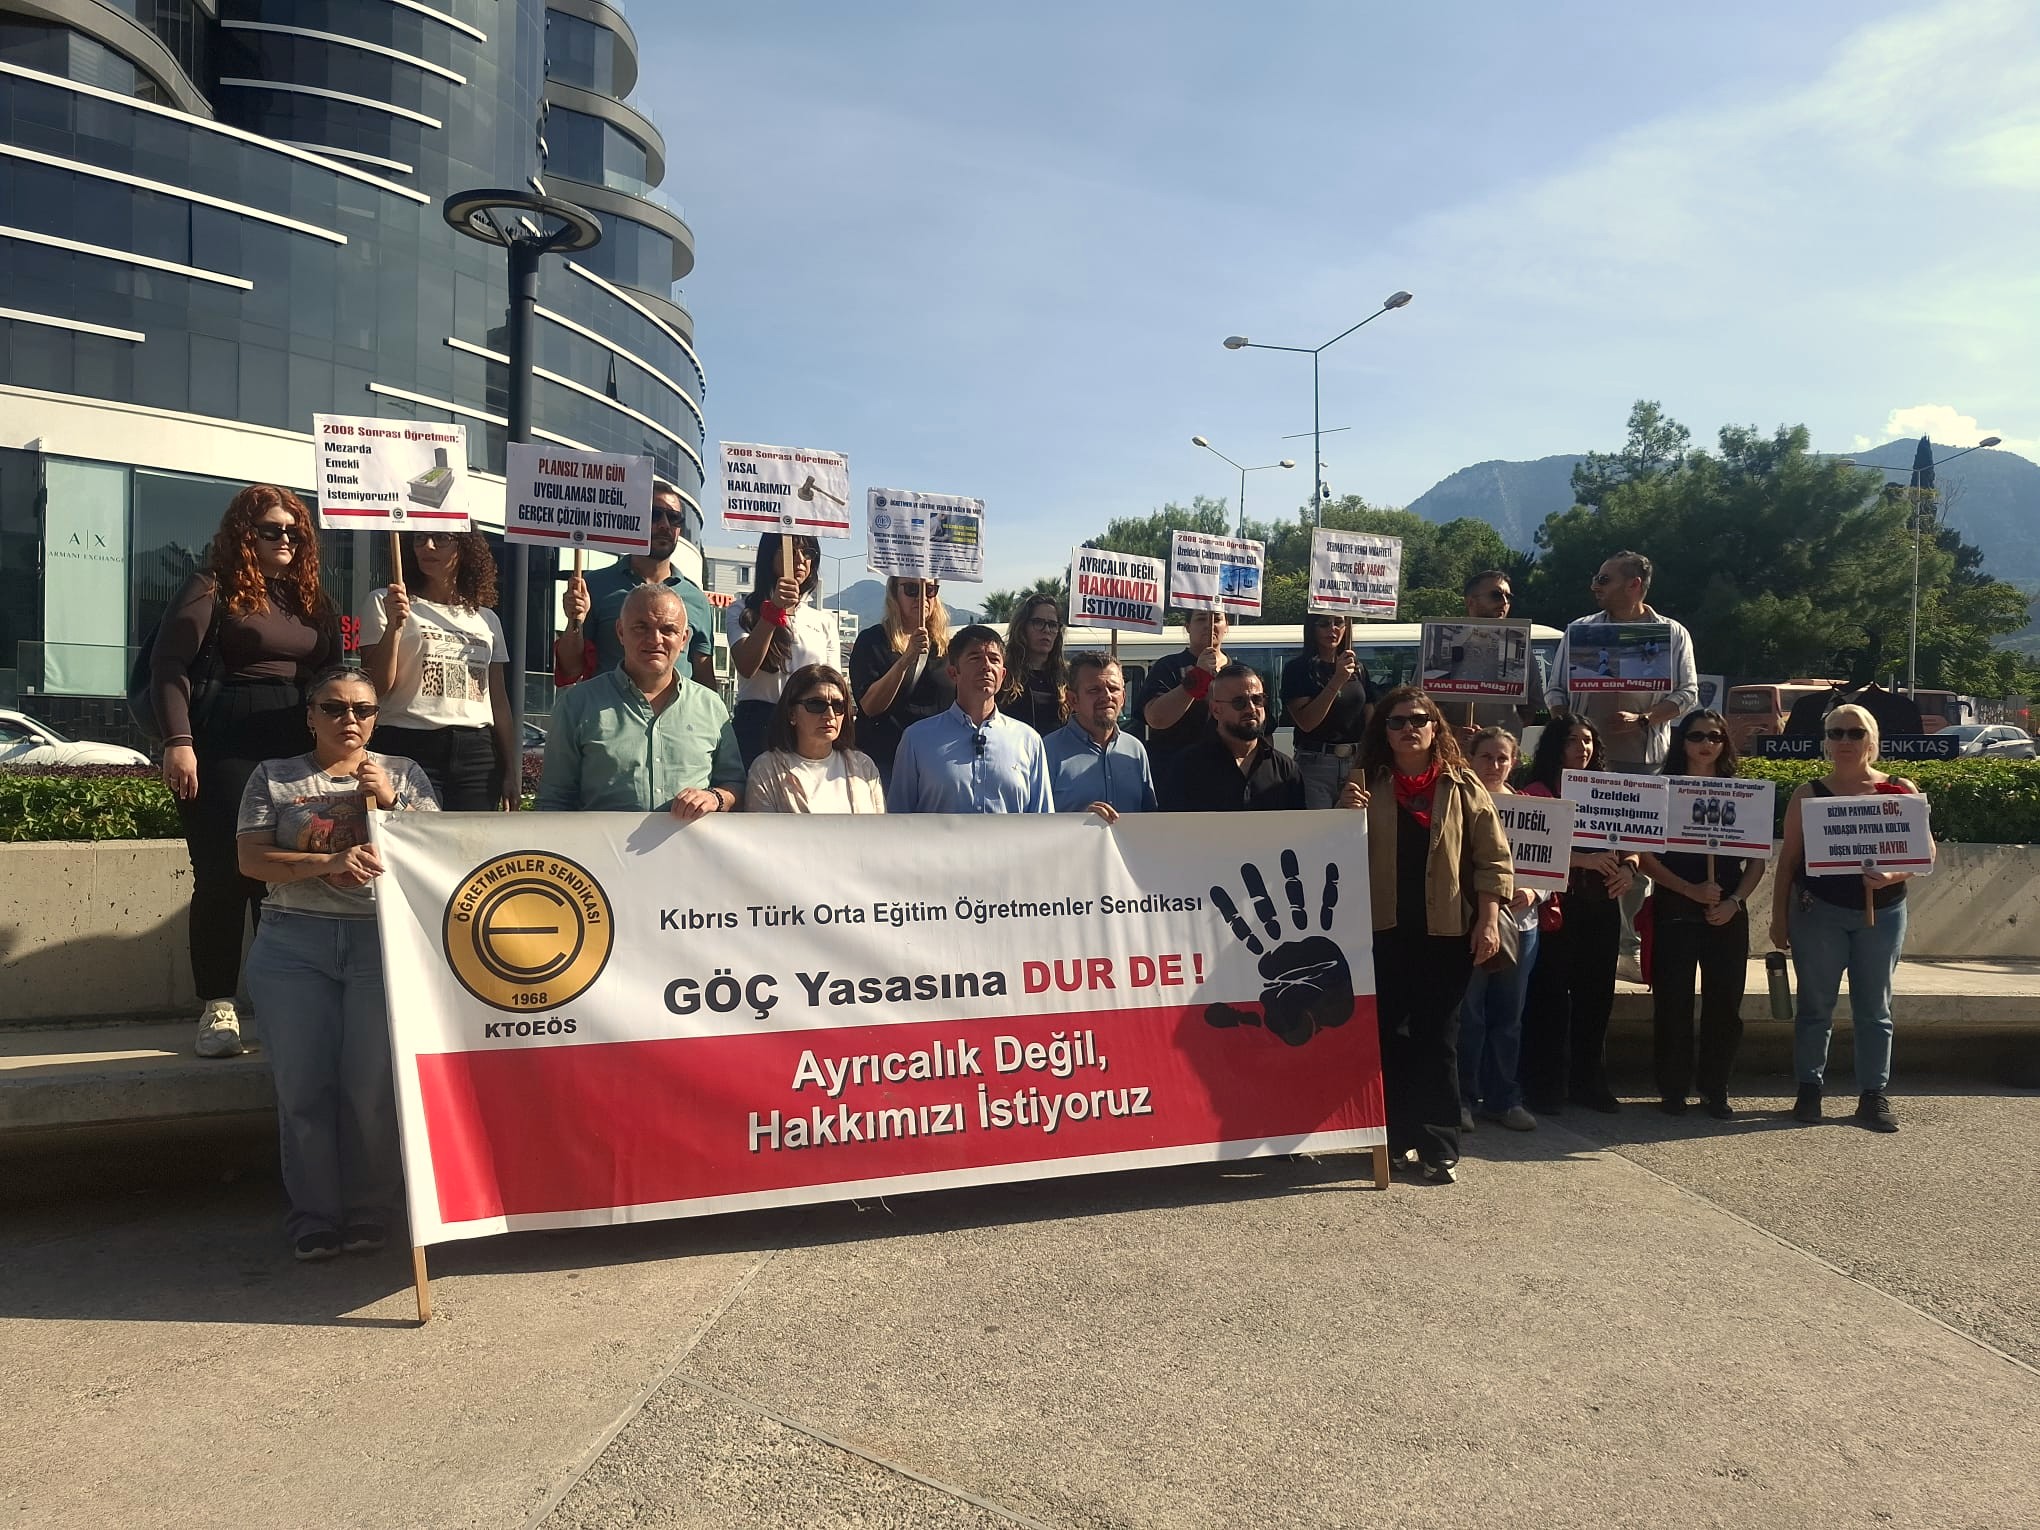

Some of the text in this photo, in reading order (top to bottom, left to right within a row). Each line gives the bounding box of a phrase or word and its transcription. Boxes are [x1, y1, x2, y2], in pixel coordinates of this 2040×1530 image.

[323, 424, 459, 443] 2008 Sonrası Öğretmen:
[325, 442, 371, 454] Mezarda
[727, 448, 752, 457] 2008
[756, 450, 792, 461] Sonrası
[325, 458, 359, 469] Emekli
[539, 458, 625, 482] PLANSIZ TAM GÜN
[727, 462, 758, 475] YASAL
[327, 474, 358, 485] Olmak
[728, 480, 791, 495] HAKLARIMIZI
[327, 488, 399, 502] İstemiyoruz!!!
[534, 482, 628, 508] UYGULAMASI DEĞİL,
[728, 496, 781, 513] İSTİYORUZ!
[519, 504, 640, 531] GERÇEK ÇÖZÜM İSTİYORUZ
[1079, 556, 1158, 583] AYRICALIK DEĞİL,
[1078, 575, 1158, 603] HAKKIMIZI
[1082, 595, 1153, 620] İSTİYORUZ
[1765, 740, 1813, 753] RAUF
[1880, 740, 1950, 756] ENKTAŞ
[1567, 774, 1588, 783] 2008
[1591, 787, 1640, 803] Özeldeki
[1827, 800, 1903, 818] BİZİM PAYIMIZA GÖÇ,
[1517, 810, 1551, 836] DEĞİL,
[1574, 819, 1663, 836] ok SAYILAMAZ!
[1859, 823, 1883, 834] PAYINA
[1516, 843, 1553, 864] ARTIR!
[1829, 844, 1851, 857] DÜŞEN
[1879, 840, 1908, 854] HAYIR!
[454, 859, 601, 924] ÖĞRETMENLER SENDİKASI
[660, 894, 1202, 931] Kıbrıs Türk Orta Eğitim Öğretmenler Sendikası
[664, 968, 779, 1020] GÖÇ
[795, 971, 1007, 1007] Yasasına
[1022, 957, 1116, 994] DUR
[1128, 954, 1184, 988] DE
[511, 992, 548, 1006] 1968
[485, 1016, 577, 1039] KTOEÖS
[791, 1029, 1109, 1098] Ayrıcalık Değil,
[748, 1083, 1153, 1153] Hakkımızı İstiyoruz
